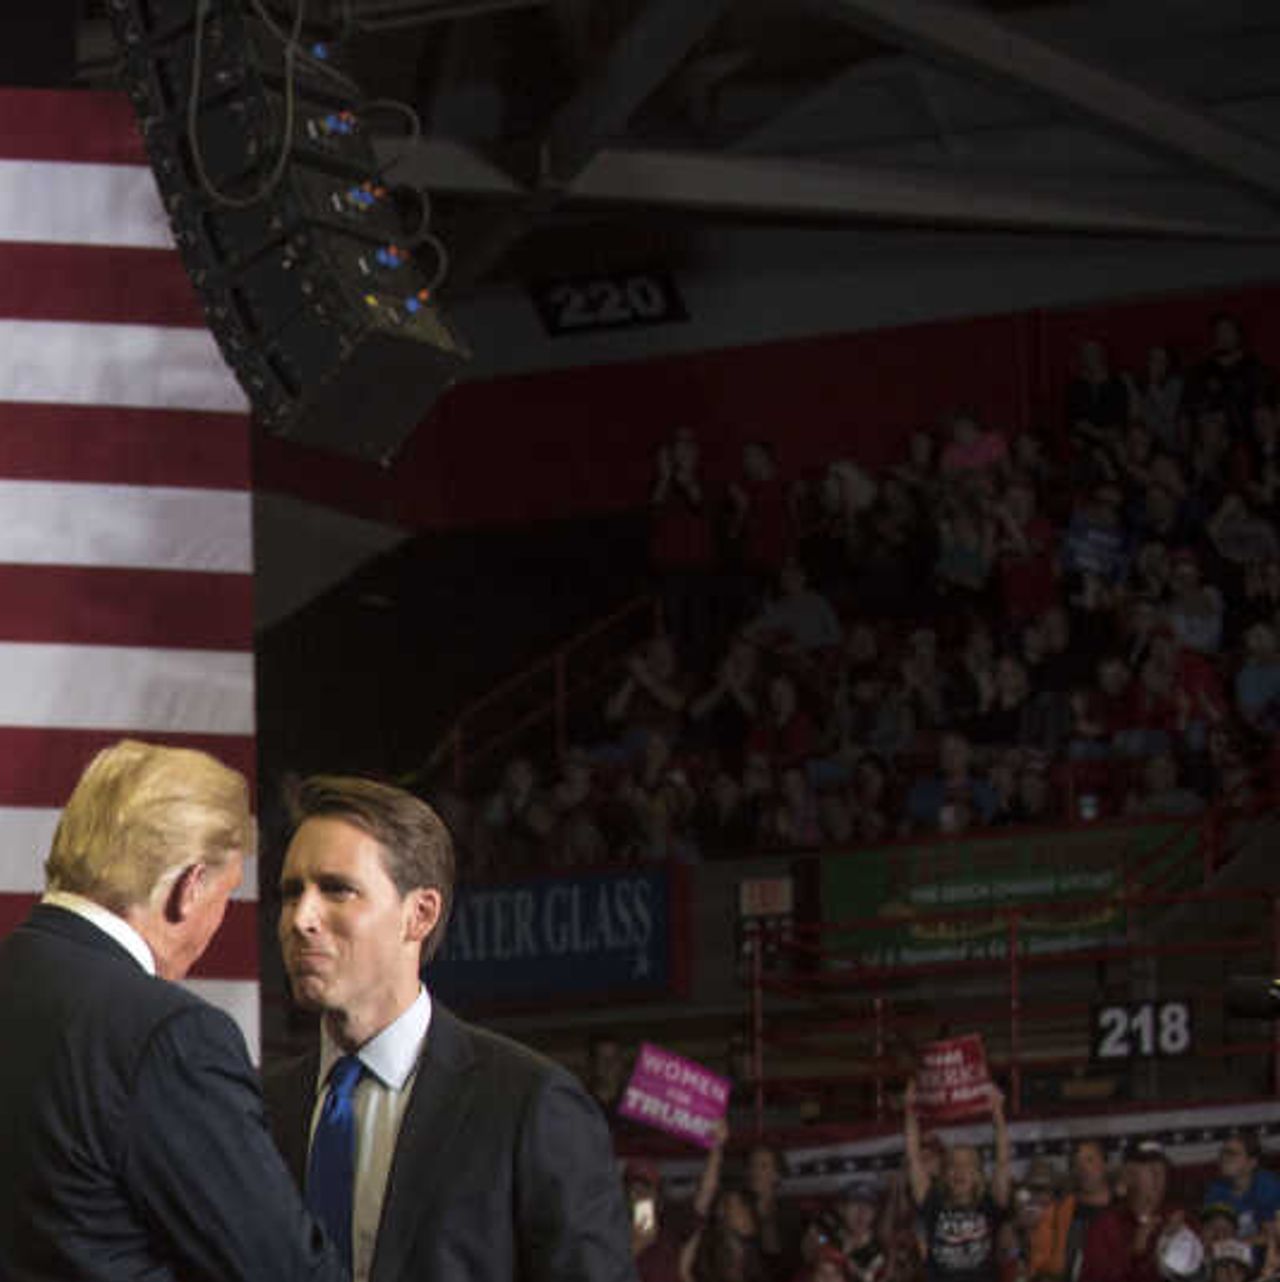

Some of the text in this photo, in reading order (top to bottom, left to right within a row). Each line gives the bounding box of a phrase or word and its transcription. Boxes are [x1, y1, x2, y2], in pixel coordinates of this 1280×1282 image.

[550, 275, 667, 327] 220
[449, 888, 539, 961] ATER
[543, 878, 653, 954] GLASS
[1097, 1001, 1191, 1057] 218
[642, 1052, 726, 1103] WOMEN
